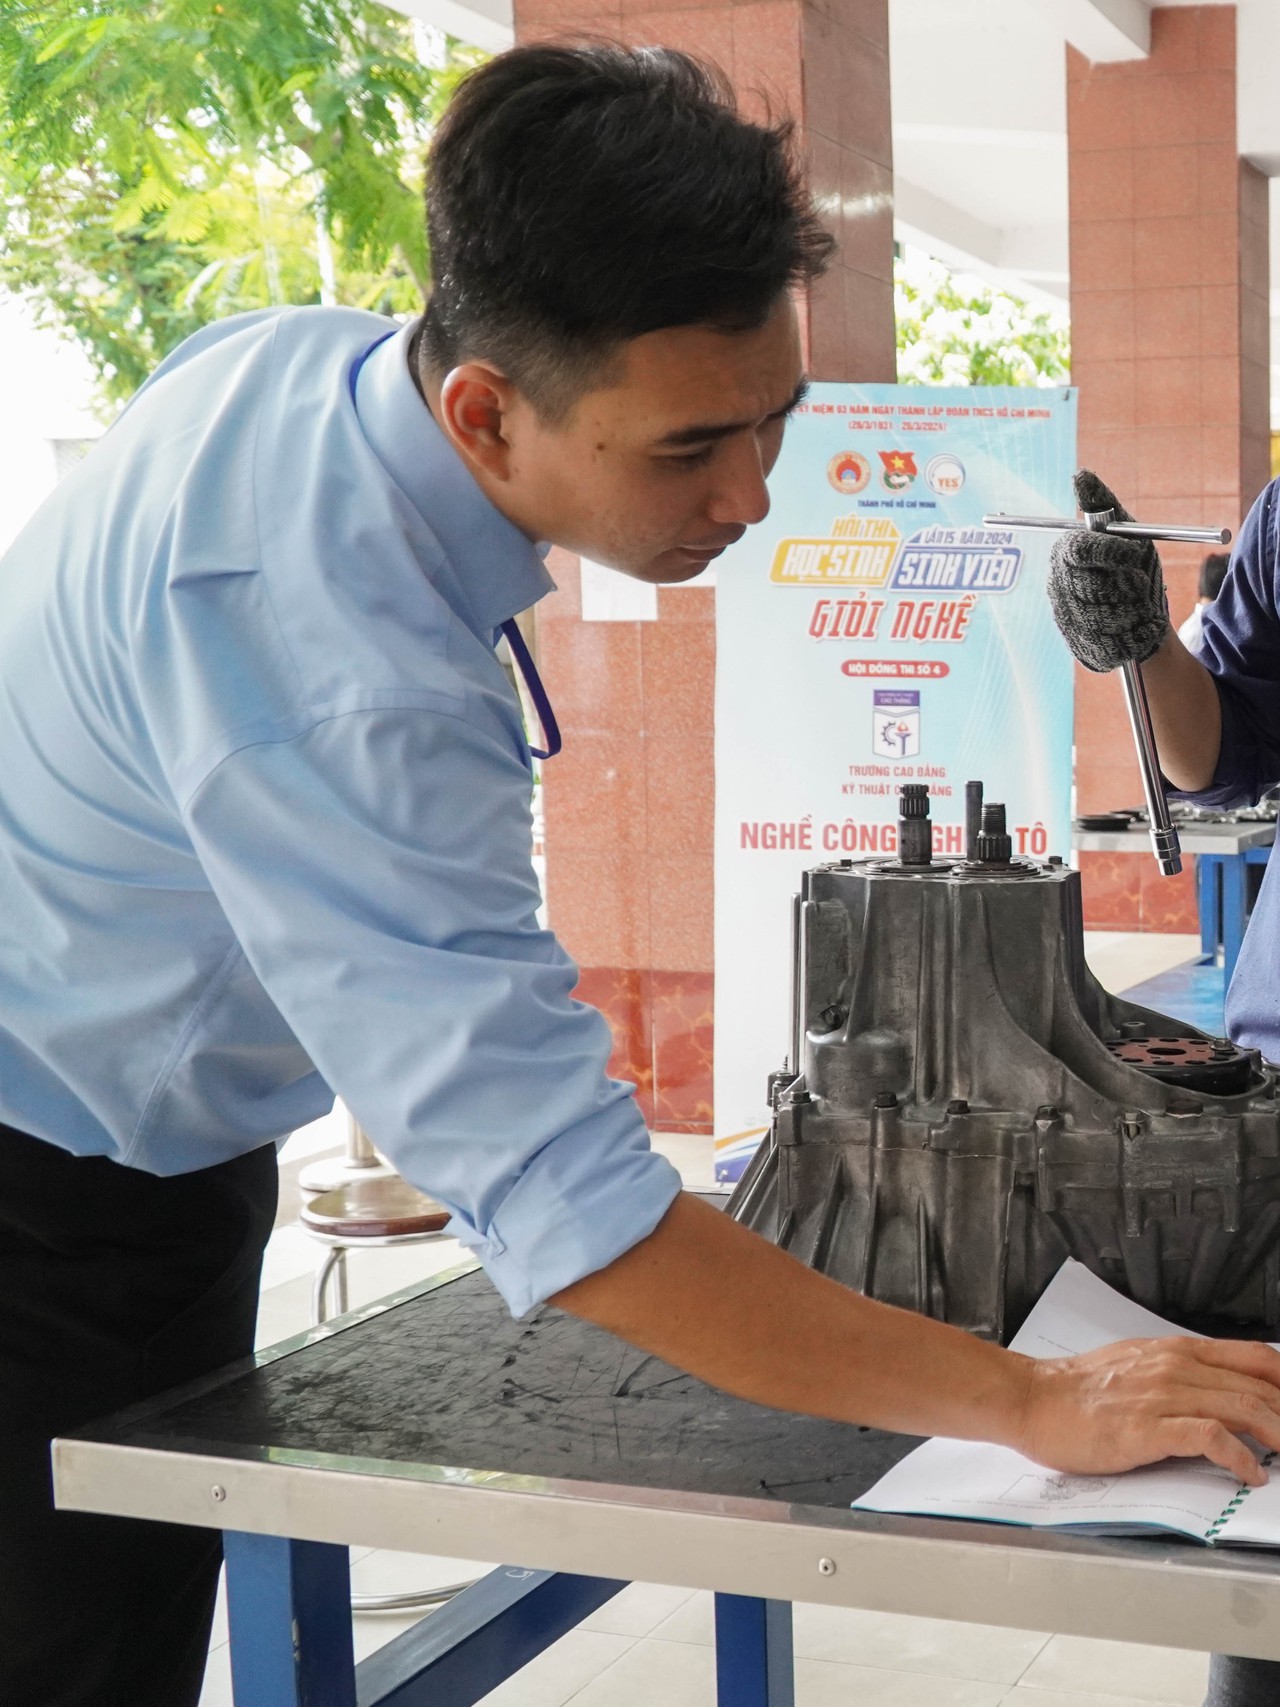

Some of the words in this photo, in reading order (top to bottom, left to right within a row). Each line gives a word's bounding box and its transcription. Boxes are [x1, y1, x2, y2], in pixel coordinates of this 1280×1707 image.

[938, 477, 959, 488] YES
[864, 519, 891, 538] THI
[944, 531, 955, 544] 15
[984, 532, 1013, 545] 2024
[828, 544, 890, 578] SINH
[898, 552, 963, 587] SINH
[963, 548, 1018, 587] VIÊN
[808, 591, 887, 638] GIỎI
[890, 593, 977, 641] NGHỀ
[848, 661, 866, 675] HỘI
[900, 664, 914, 674] THI
[917, 662, 931, 675] SỐ
[933, 664, 941, 675] 4
[848, 764, 890, 777] TRƯỜNG
[893, 766, 914, 777] CAO
[859, 782, 891, 797] THUẬT
[740, 814, 813, 850] NGHỀ
[823, 818, 896, 853] CÔNG
[931, 824, 962, 853] GH
[1015, 821, 1047, 855] TÔ
